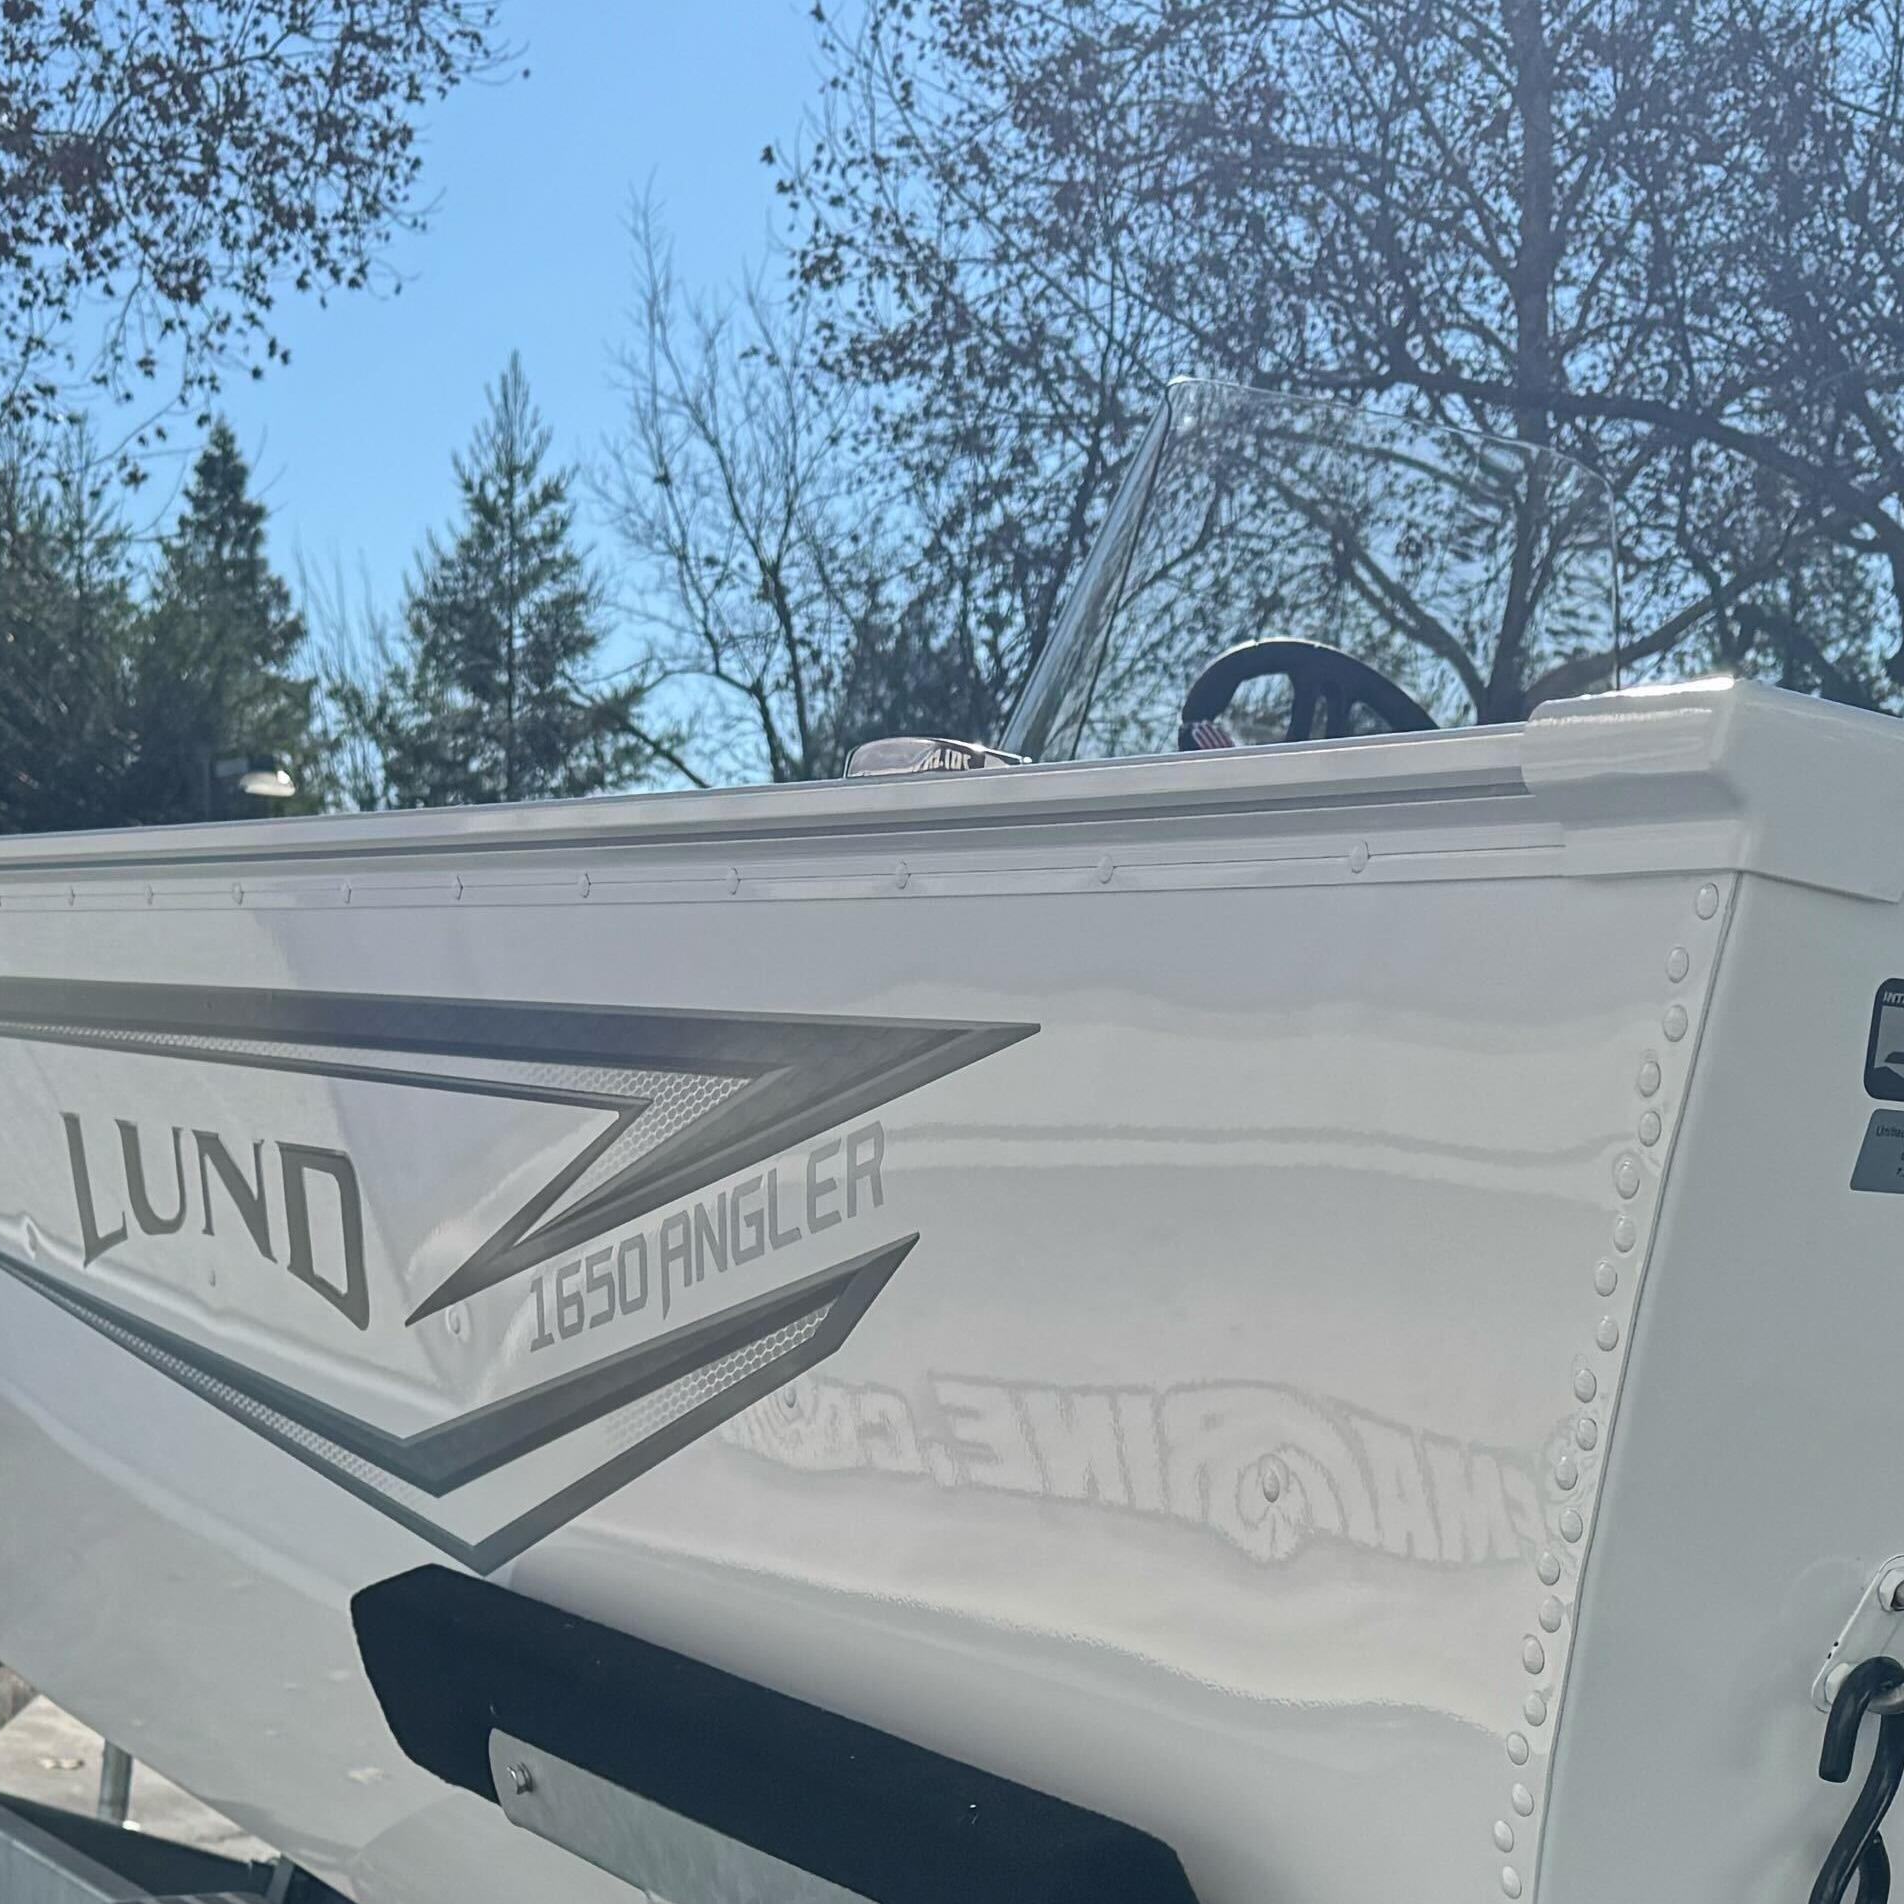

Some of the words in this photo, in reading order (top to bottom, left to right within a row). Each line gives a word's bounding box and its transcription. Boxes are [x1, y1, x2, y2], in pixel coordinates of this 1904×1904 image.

[60, 1111, 371, 1330] LUND
[530, 1233, 648, 1352] 1650
[659, 1120, 884, 1320] ANGLER
